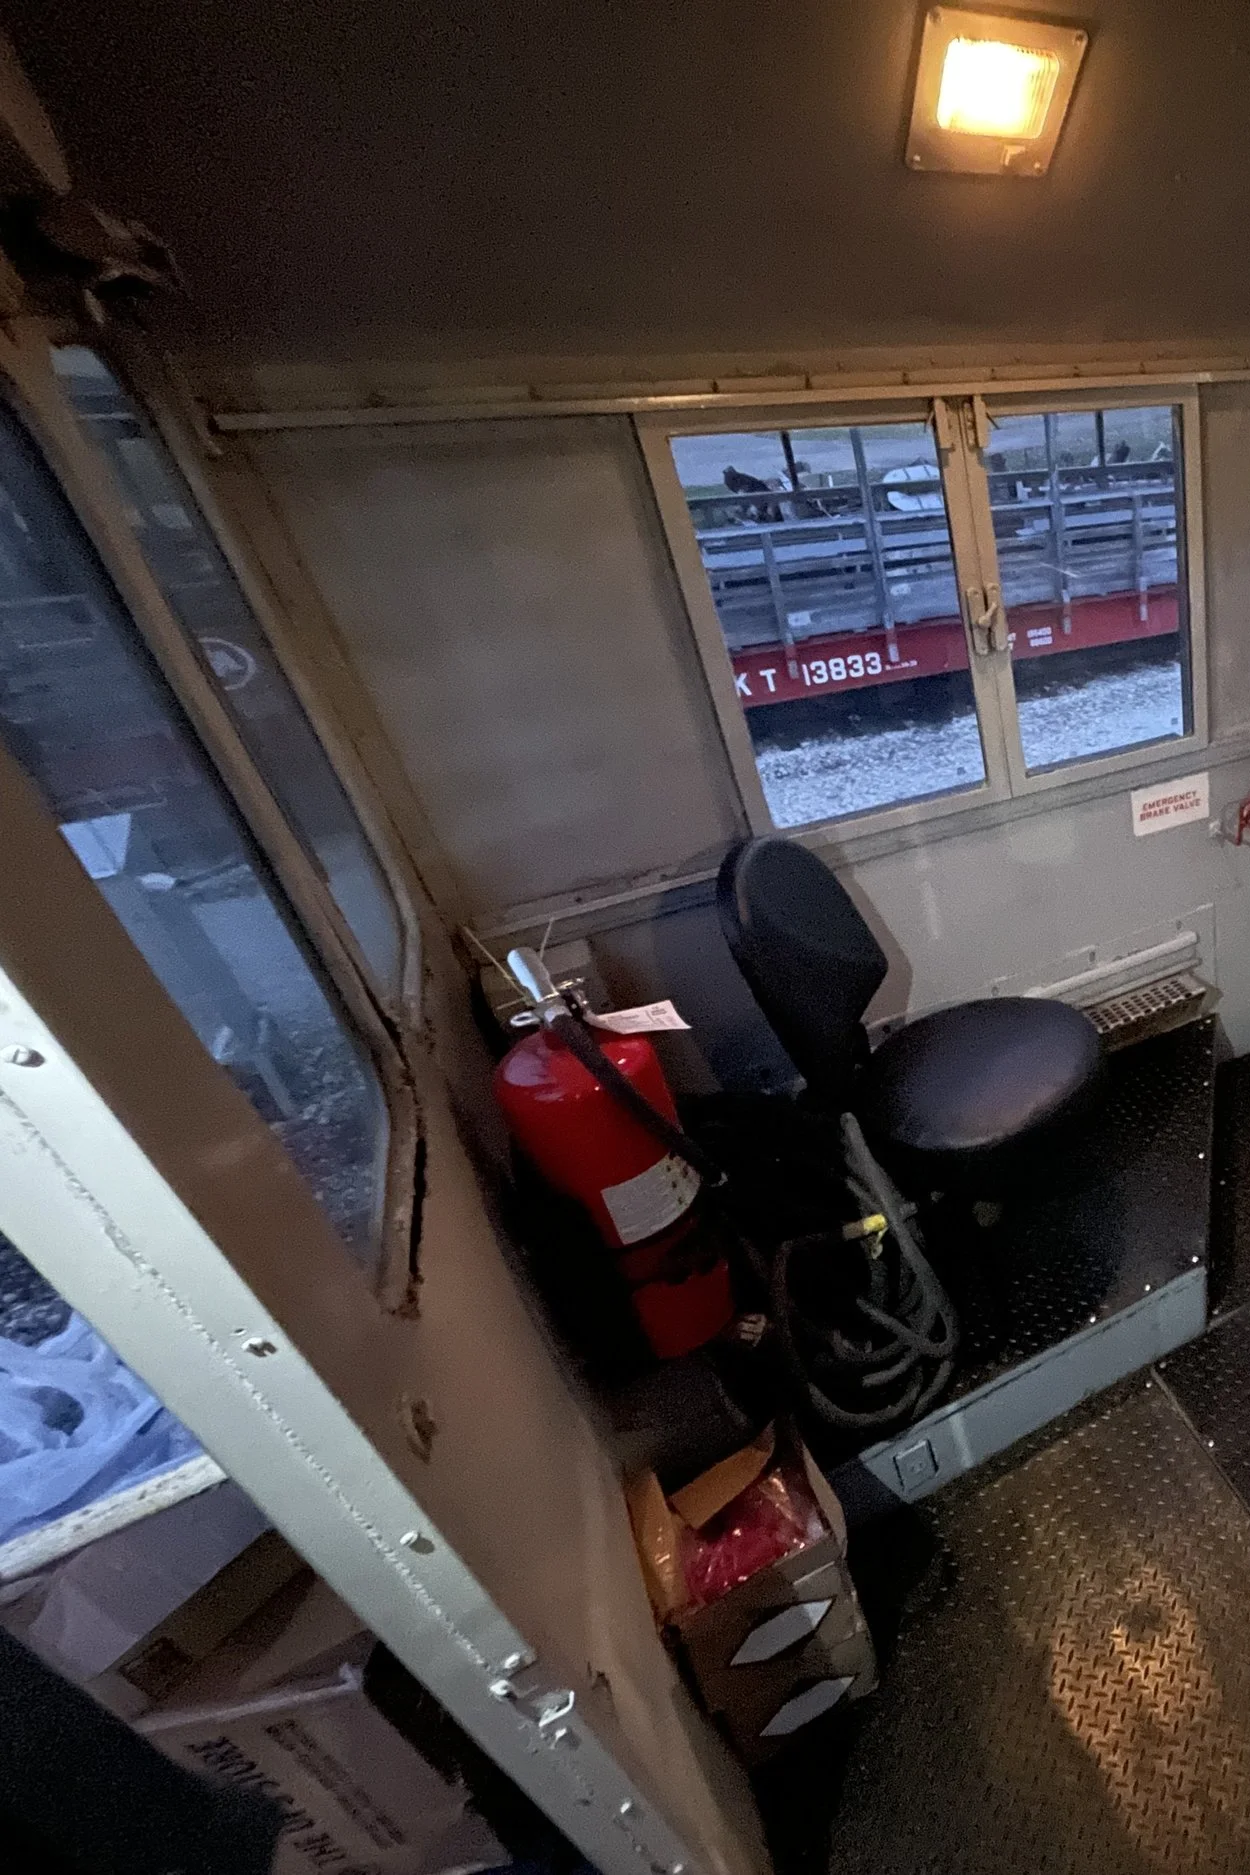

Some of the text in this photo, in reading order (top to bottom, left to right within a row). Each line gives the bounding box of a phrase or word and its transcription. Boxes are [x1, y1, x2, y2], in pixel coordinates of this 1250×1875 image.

[802, 652, 882, 686] 13833
[1140, 798, 1200, 821] BRAKE VALVE
[1142, 790, 1197, 811] EMERGENCY
